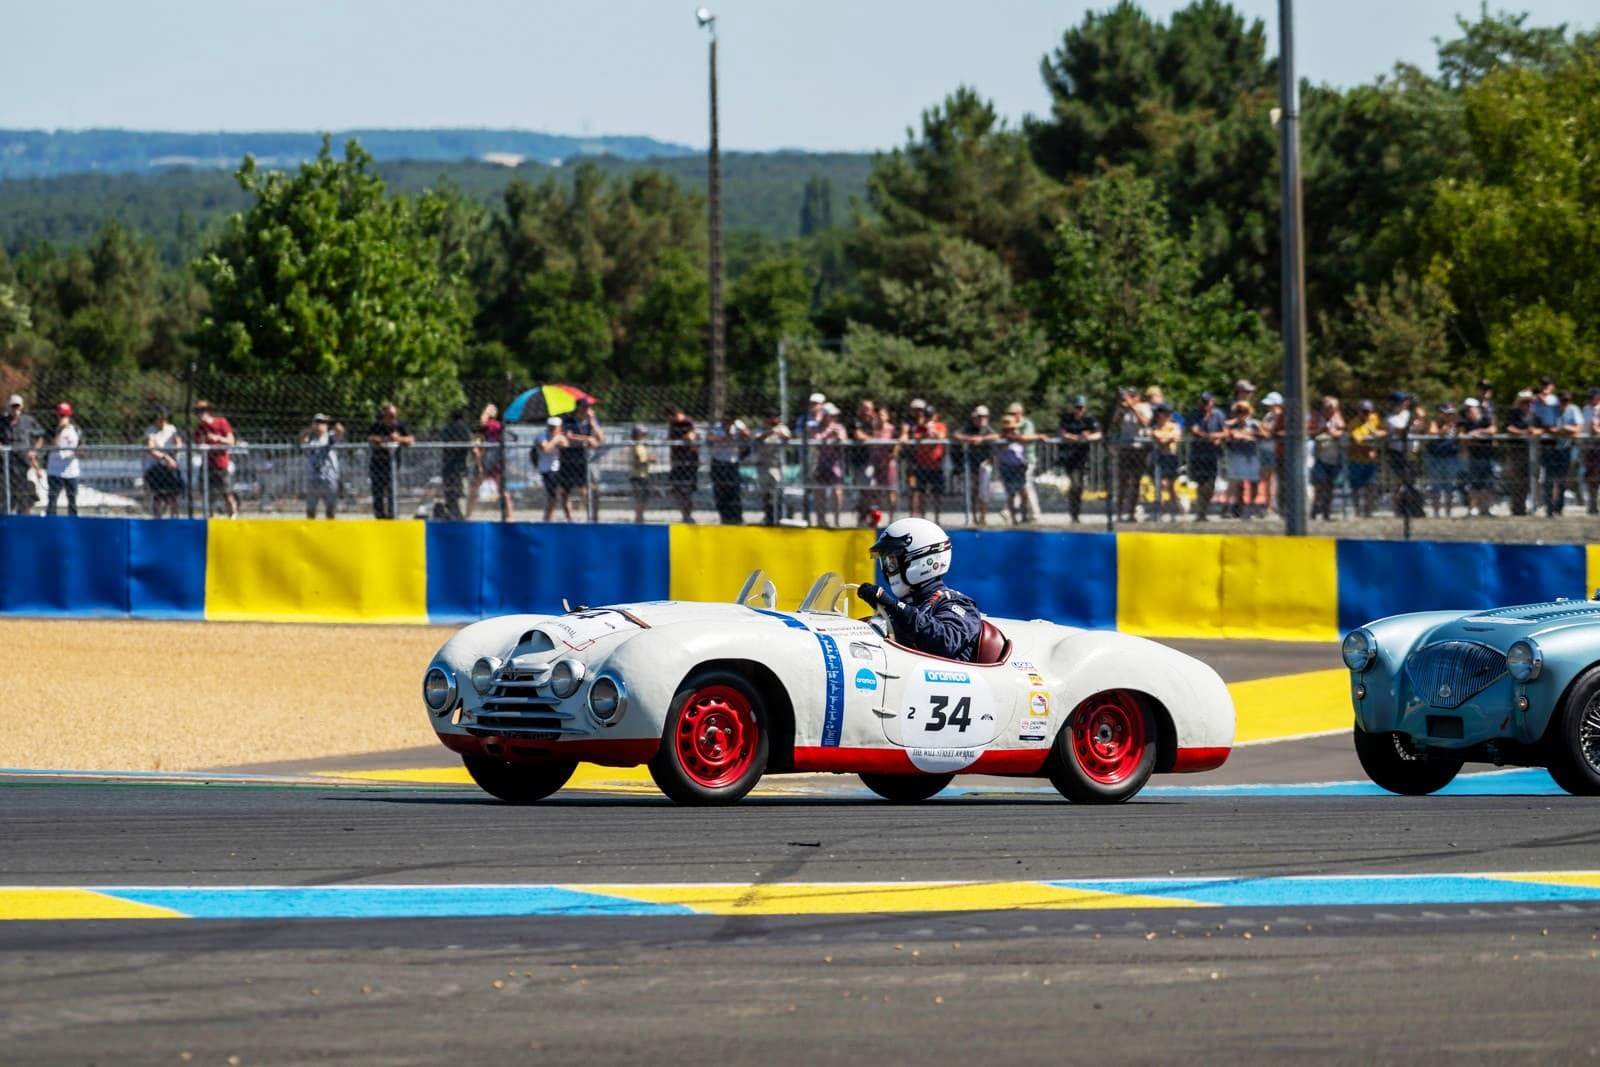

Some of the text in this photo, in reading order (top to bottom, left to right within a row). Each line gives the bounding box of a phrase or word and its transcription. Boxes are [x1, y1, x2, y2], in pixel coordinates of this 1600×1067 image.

[928, 671, 967, 682] aramco
[907, 706, 916, 720] 2
[924, 695, 972, 733] 34
